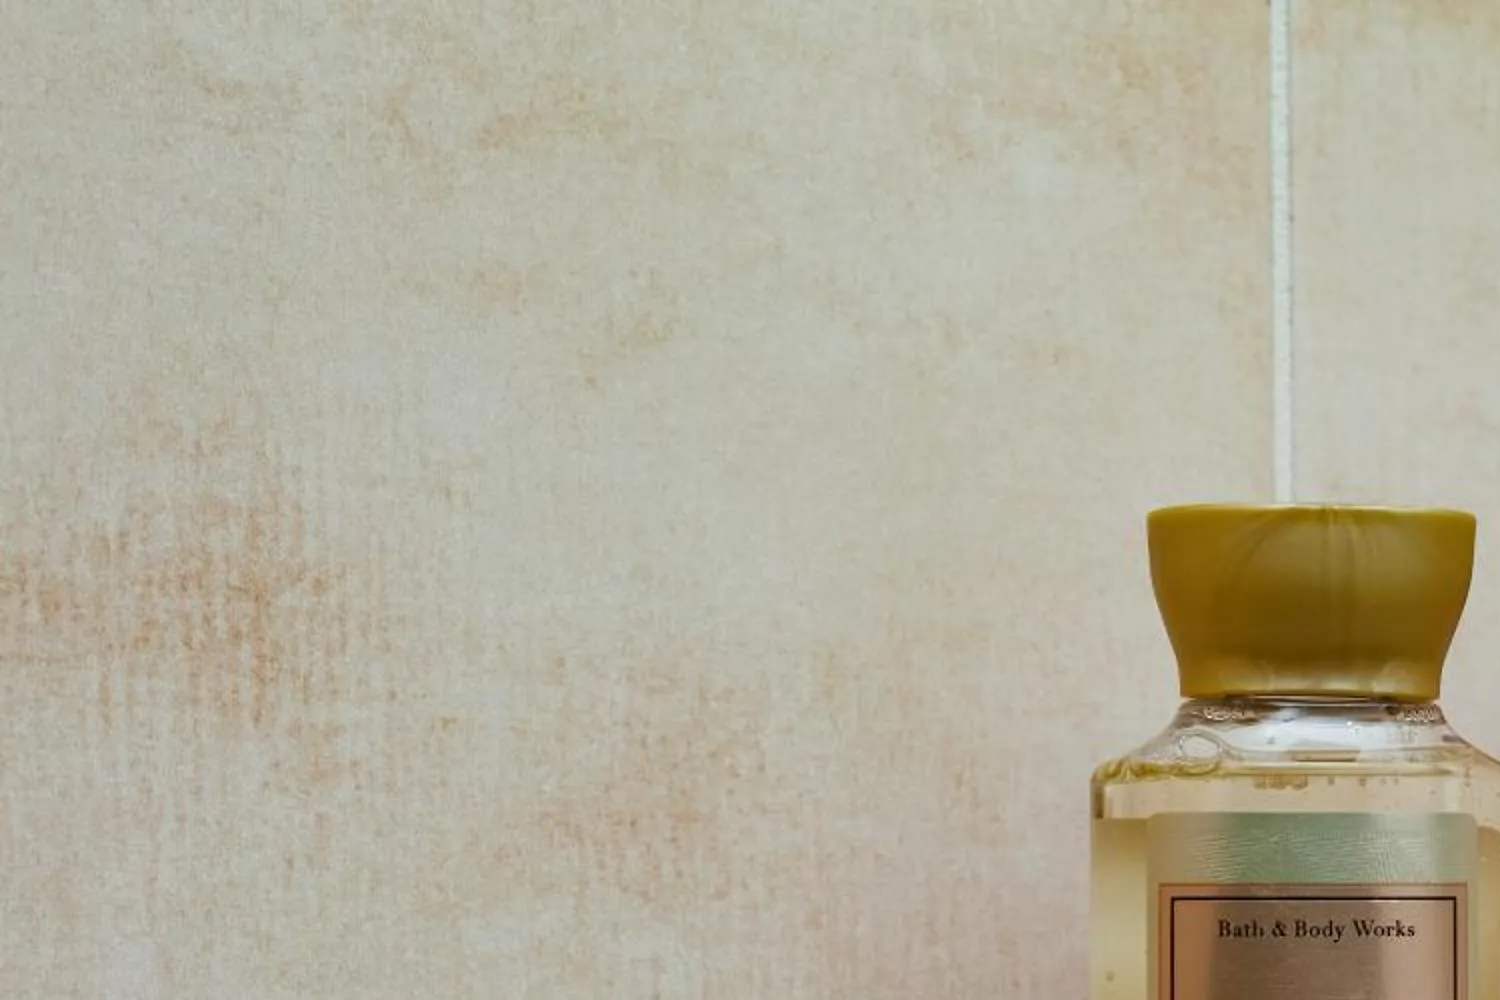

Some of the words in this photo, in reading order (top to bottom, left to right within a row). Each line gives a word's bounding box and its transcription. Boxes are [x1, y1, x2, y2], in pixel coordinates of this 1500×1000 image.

[1218, 919, 1265, 939] Bath
[1271, 921, 1288, 938] &
[1294, 919, 1346, 943] Body
[1353, 919, 1416, 939] Works
